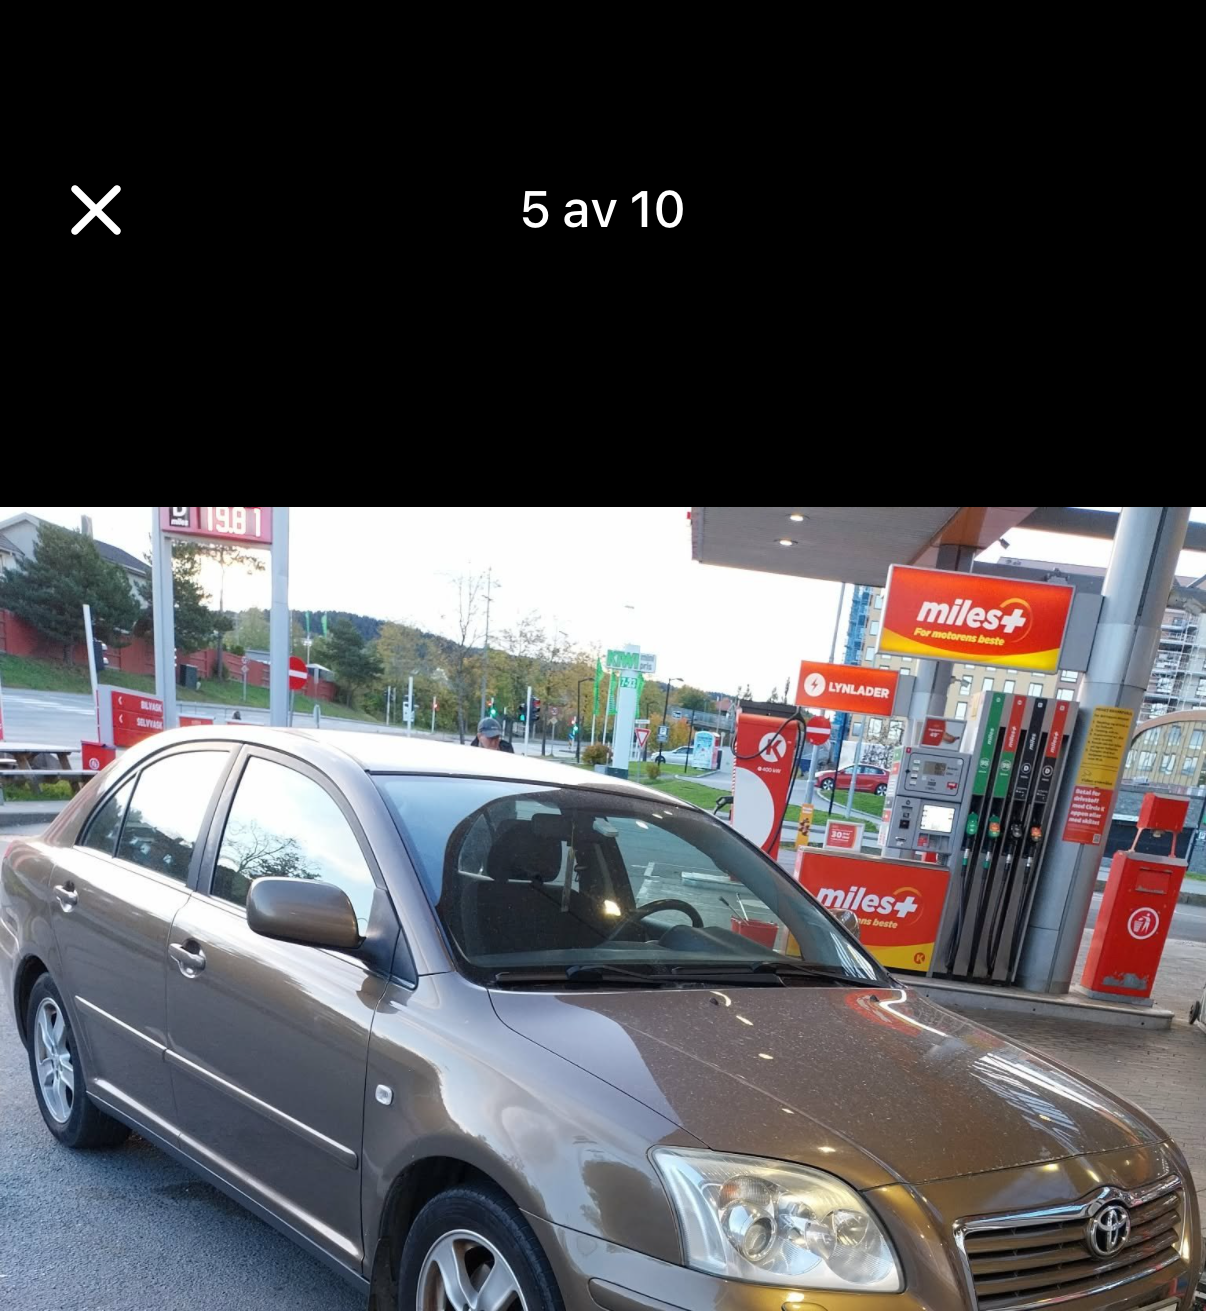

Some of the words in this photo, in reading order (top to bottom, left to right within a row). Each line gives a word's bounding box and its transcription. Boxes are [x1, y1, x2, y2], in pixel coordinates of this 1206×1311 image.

[913, 627, 931, 638] For
[931, 630, 977, 645] motorens
[978, 634, 1005, 646] beste
[607, 649, 640, 669] KIWI
[639, 662, 653, 671] pris
[620, 677, 636, 688] 7-23
[828, 681, 890, 698] LYNLADER
[140, 700, 163, 713] BILVASK
[1029, 733, 1037, 751] miles
[872, 917, 898, 929] beste
